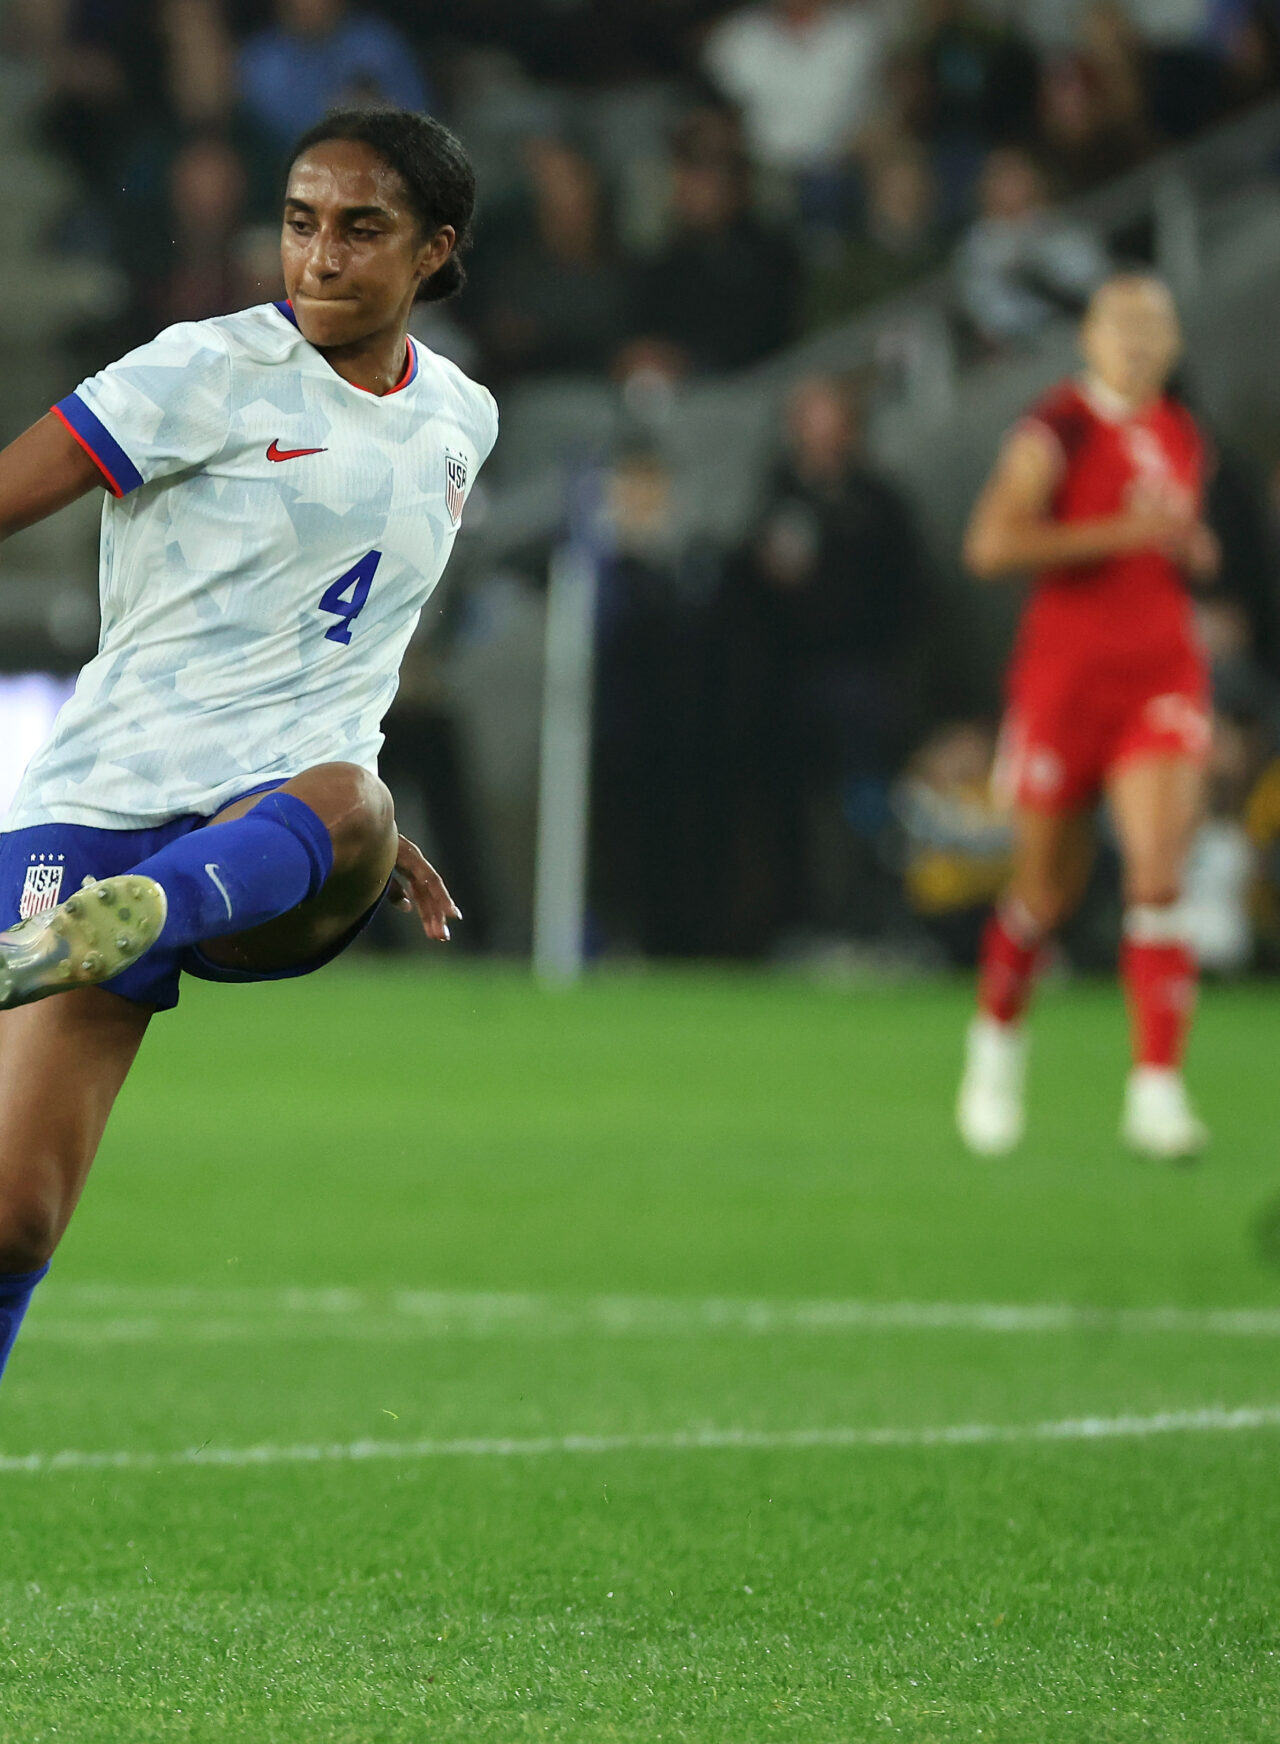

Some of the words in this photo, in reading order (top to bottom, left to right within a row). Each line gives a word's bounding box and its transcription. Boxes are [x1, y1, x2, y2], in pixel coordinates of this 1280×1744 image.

[447, 460, 467, 490] USA
[317, 549, 382, 646] 4
[27, 868, 61, 893] USA
